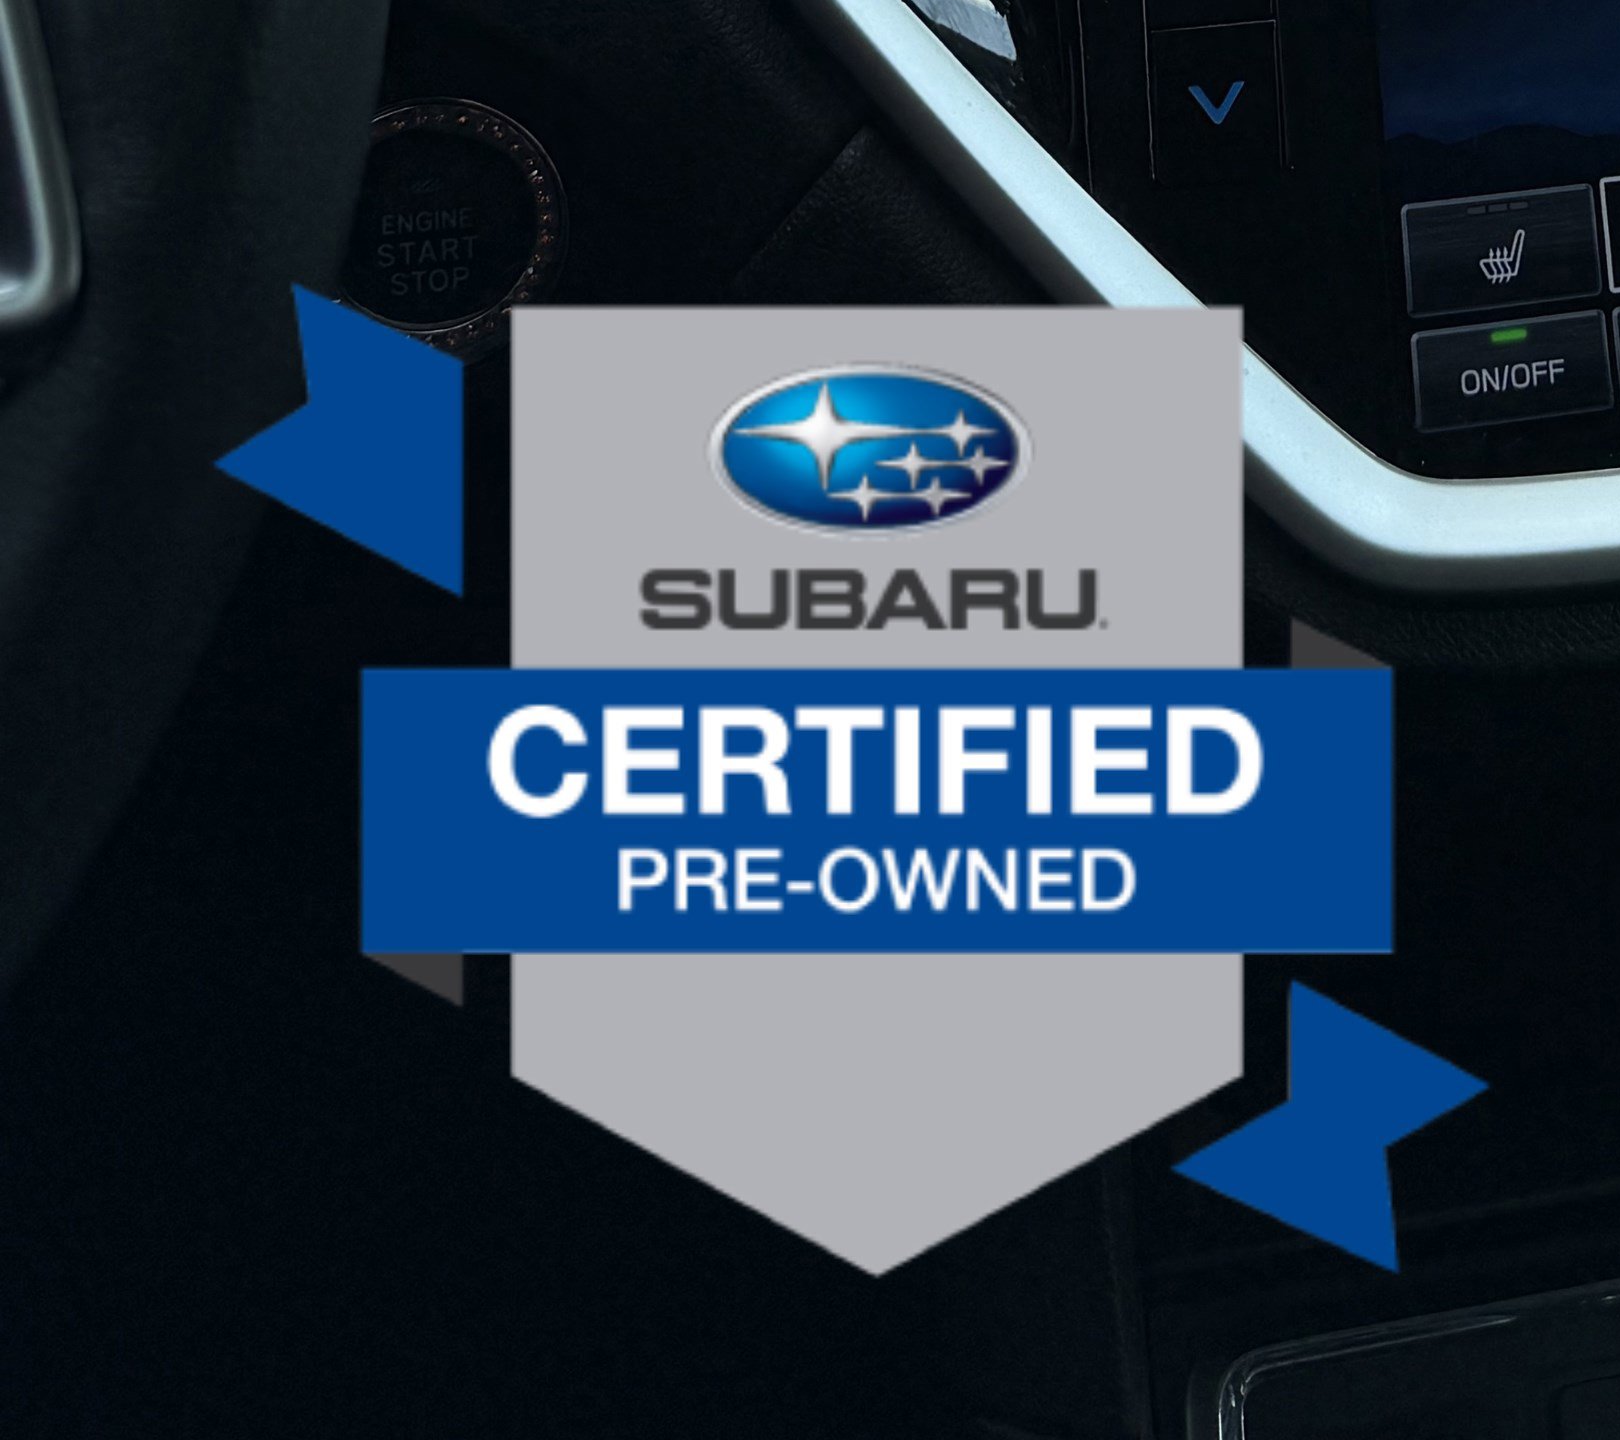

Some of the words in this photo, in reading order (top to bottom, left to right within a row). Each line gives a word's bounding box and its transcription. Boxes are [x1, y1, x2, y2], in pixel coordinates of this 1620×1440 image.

[381, 207, 475, 236] ENGINE
[377, 235, 478, 268] START
[390, 267, 470, 296] STOP
[1460, 358, 1565, 395] ON/OFF
